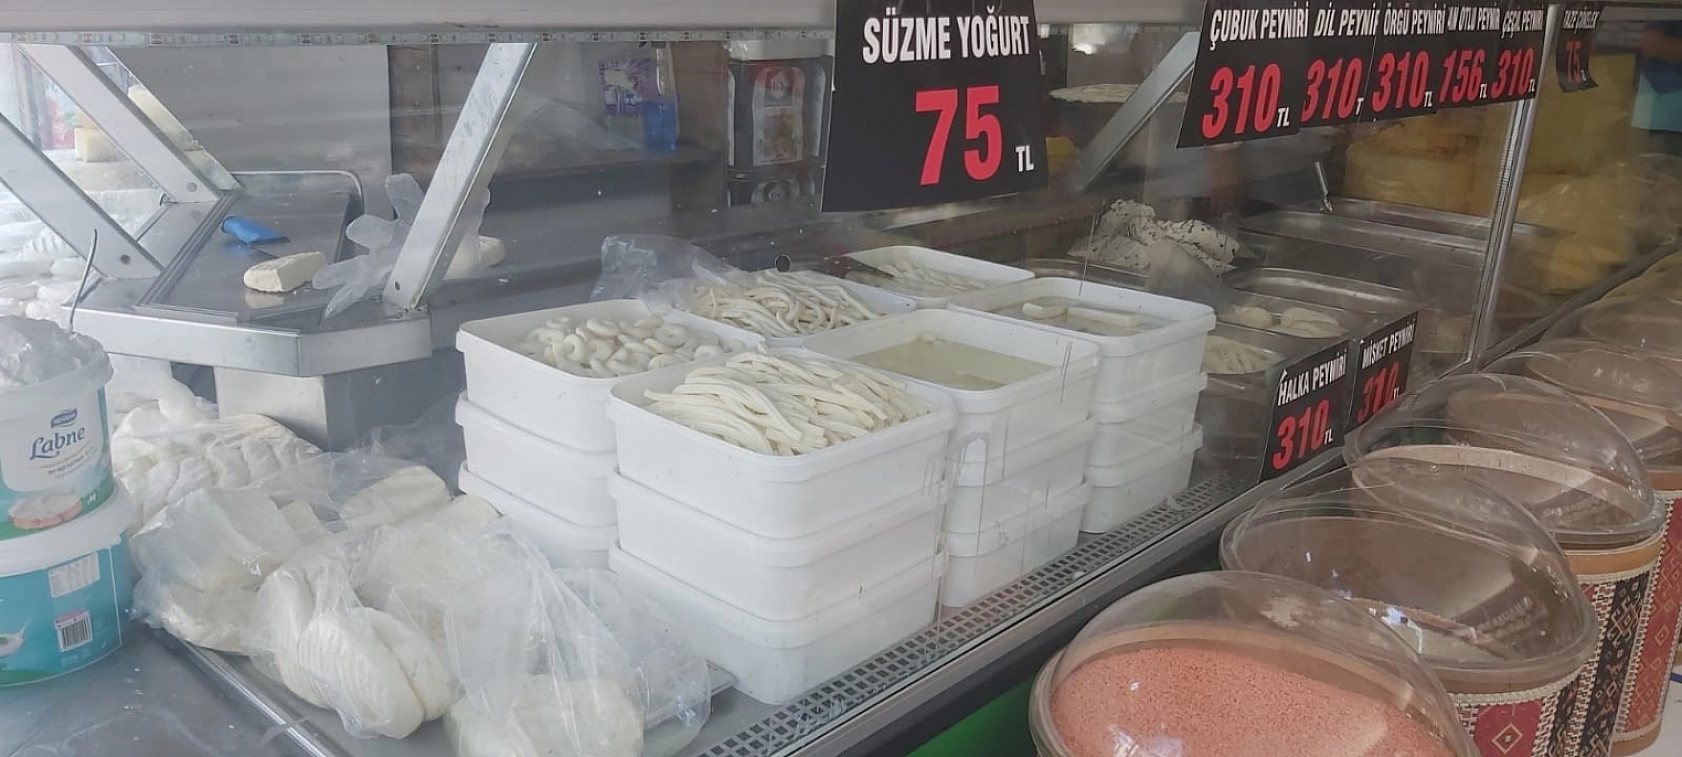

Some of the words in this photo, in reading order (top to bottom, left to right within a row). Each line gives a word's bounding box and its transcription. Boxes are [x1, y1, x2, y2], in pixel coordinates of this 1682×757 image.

[863, 7, 950, 64] SÜZME
[957, 5, 1030, 58] YOĞURT
[1210, 9, 1259, 51] ÇUBUK
[1259, 1, 1309, 39] PEYNİRİ
[1313, 2, 1336, 36] DİL
[1383, 2, 1411, 36] ÖRGÜ
[1411, 2, 1447, 35] PEYNİRİ
[1202, 63, 1281, 139] 310
[1276, 107, 1290, 127] TL
[1301, 57, 1363, 122] 310
[1355, 97, 1364, 115] T
[1372, 51, 1429, 112] 310
[1423, 91, 1433, 107] TL
[1438, 49, 1485, 104] 156
[1479, 83, 1488, 99] TL
[1490, 47, 1534, 99] 310
[915, 85, 1003, 186] 75
[1015, 145, 1034, 172] TL
[1277, 370, 1310, 406] HALKA
[1312, 347, 1347, 391] PEYNİRİ
[1362, 337, 1388, 370] MİSKET
[1357, 362, 1400, 423] 310
[29, 427, 85, 460] Labne
[1272, 396, 1330, 470] 310
[1323, 428, 1334, 445] TL
